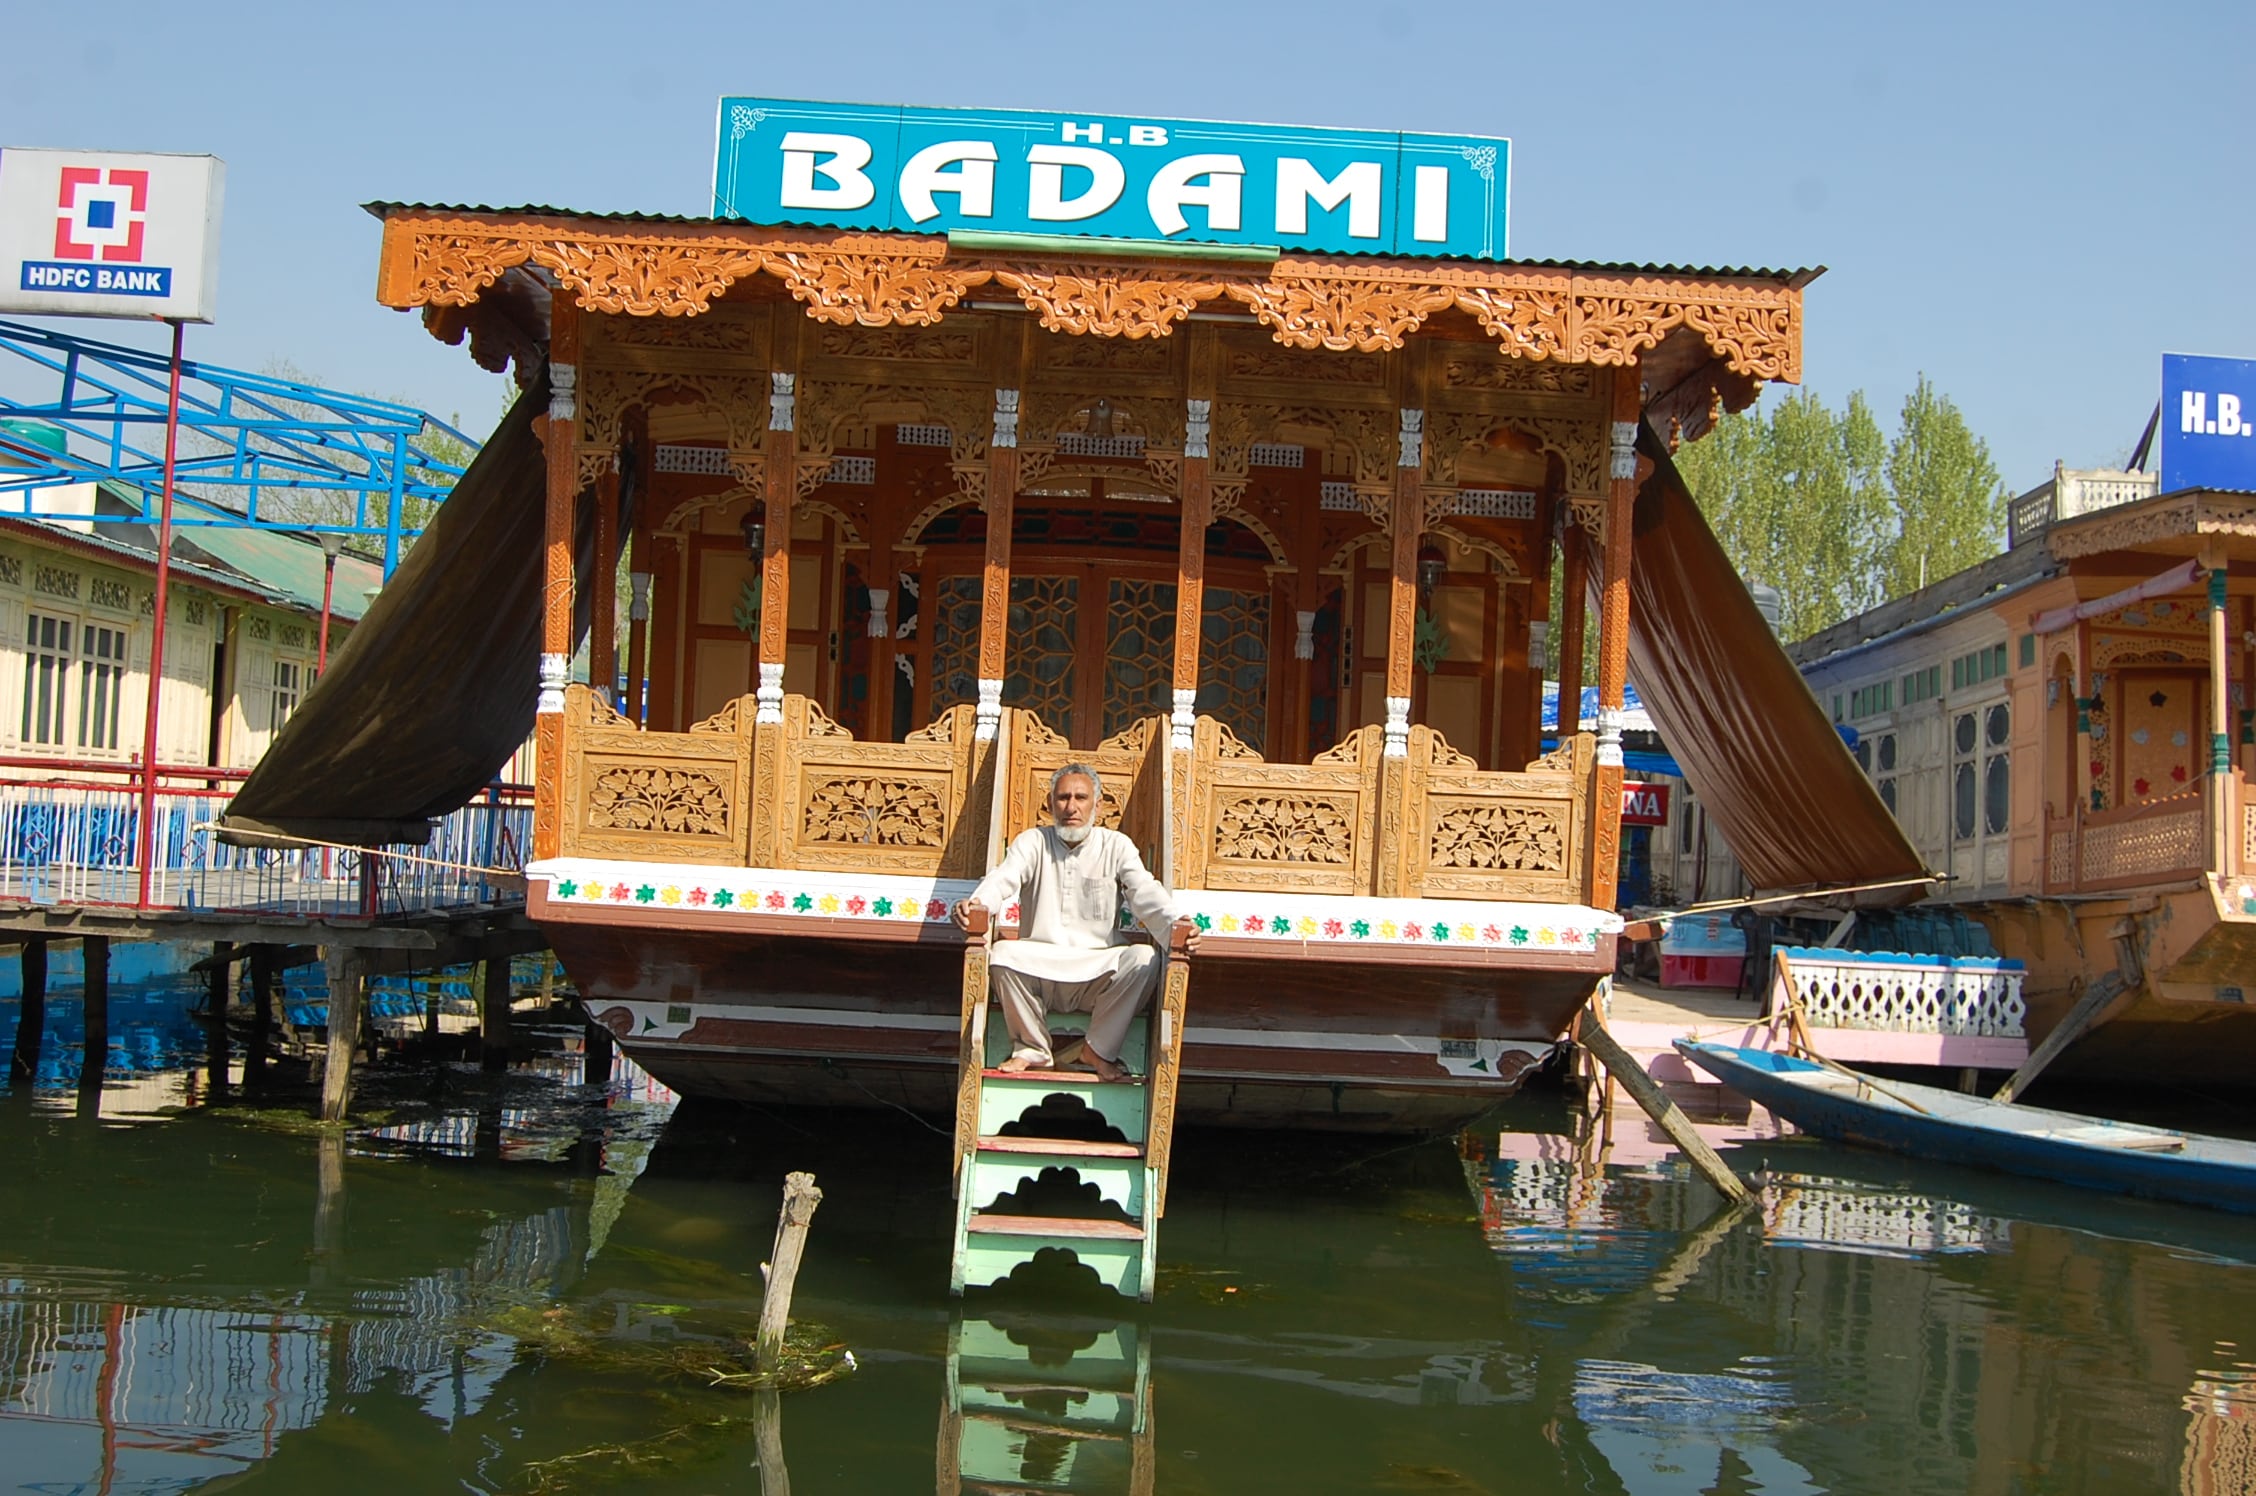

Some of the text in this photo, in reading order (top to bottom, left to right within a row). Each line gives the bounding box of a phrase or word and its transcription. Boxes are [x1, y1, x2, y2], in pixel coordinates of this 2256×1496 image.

[1060, 122, 1170, 147] H.B
[779, 131, 1450, 241] BADAMI
[29, 267, 162, 291] HDFC BANK
[2181, 391, 2252, 436] H.B.
